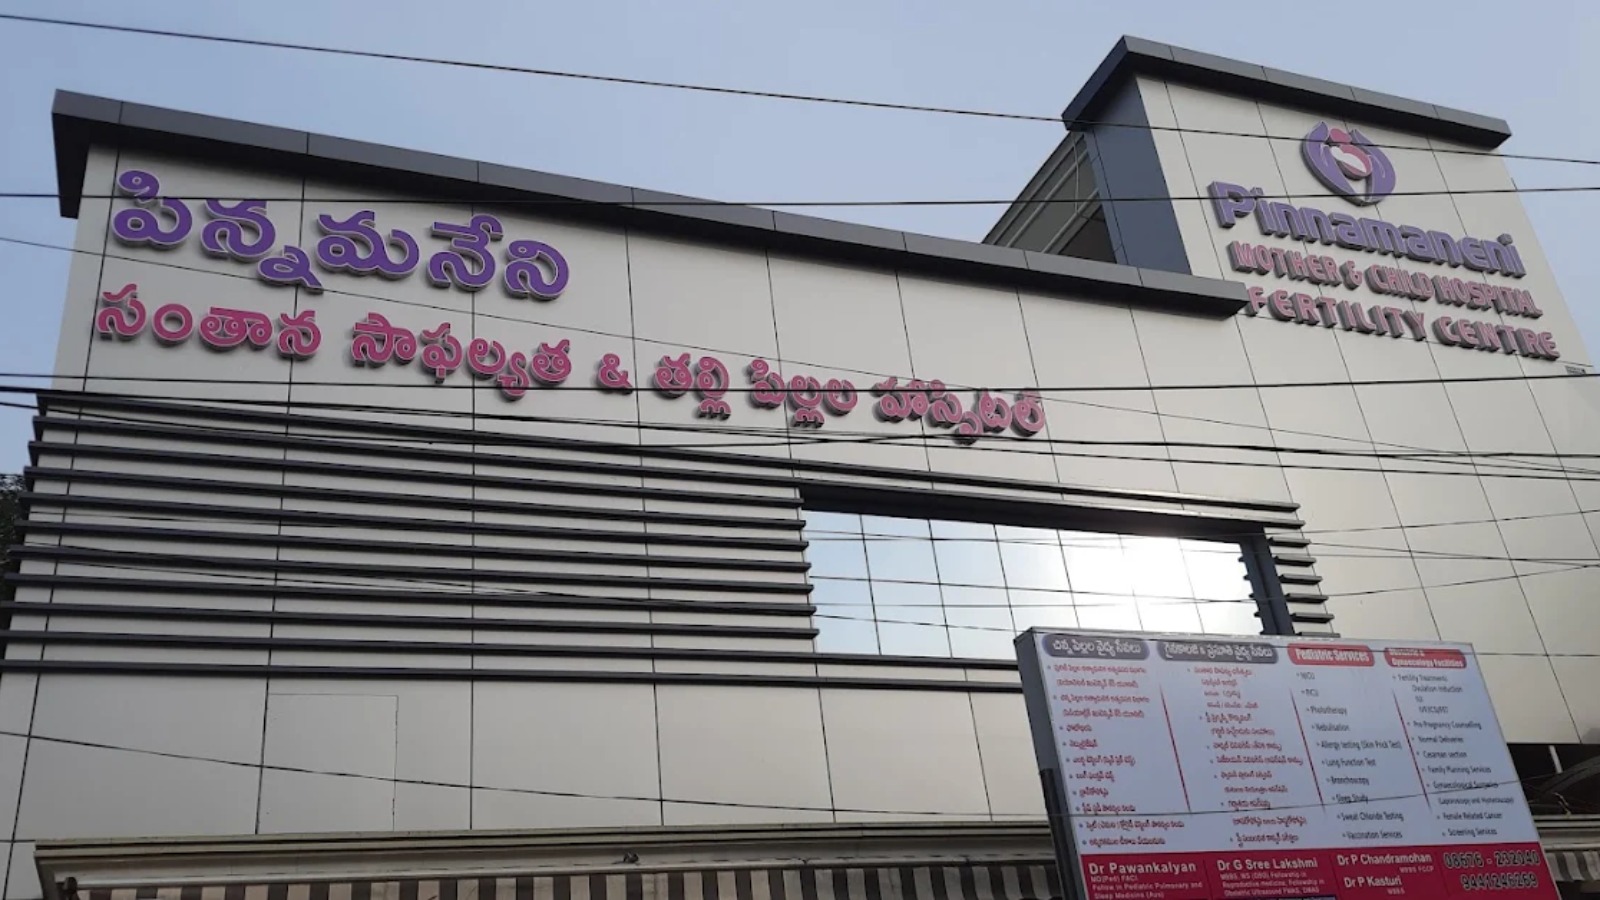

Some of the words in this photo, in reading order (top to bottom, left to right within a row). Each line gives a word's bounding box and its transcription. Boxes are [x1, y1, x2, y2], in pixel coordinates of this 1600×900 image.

[111, 169, 570, 301] పిన్నమనేని
[1207, 181, 1527, 277] Pinnamaneni
[1226, 241, 1341, 287] MOTHER
[1340, 260, 1363, 290] &
[1365, 264, 1434, 301] CHILD
[1431, 275, 1543, 319] HOSPITAL
[1246, 286, 1427, 341] FERTILITY
[1432, 316, 1561, 361] CENTRE
[97, 283, 322, 362] సంతాన
[350, 312, 572, 400] సాఫల్యత
[598, 353, 633, 395] &
[652, 352, 731, 421] తల్లి
[748, 359, 858, 429] పిల్లల
[870, 376, 1045, 445] హాస్పిటల్
[1335, 649, 1370, 662] Services
[1310, 706, 1347, 716] Phototherapy
[1325, 758, 1342, 769] Lung
[1341, 758, 1364, 767] Function
[1364, 757, 1377, 767] Test
[1427, 765, 1447, 775] Family
[1446, 765, 1470, 775] Planning
[1470, 765, 1492, 774] Services
[1359, 811, 1383, 821] Chloride
[1382, 811, 1404, 822] Testing
[1442, 812, 1462, 820] Female
[1461, 811, 1484, 820] Related
[1483, 811, 1503, 819] Cancer
[1380, 830, 1403, 839] Services
[1447, 828, 1475, 837] Screening
[1475, 828, 1498, 836] Services
[1217, 859, 1230, 871] Dr
[1233, 859, 1243, 870] G
[1245, 858, 1270, 870] Sree
[1272, 857, 1318, 869] Lakshmi
[1337, 854, 1349, 866] Dr
[1350, 854, 1358, 865] P
[1360, 852, 1433, 865] Chandramohan
[1088, 862, 1104, 875] Dr
[1109, 861, 1197, 875] Pawankalyan
[1344, 876, 1357, 888] Dr
[1357, 876, 1365, 887] P
[1366, 875, 1402, 887] Kasturi
